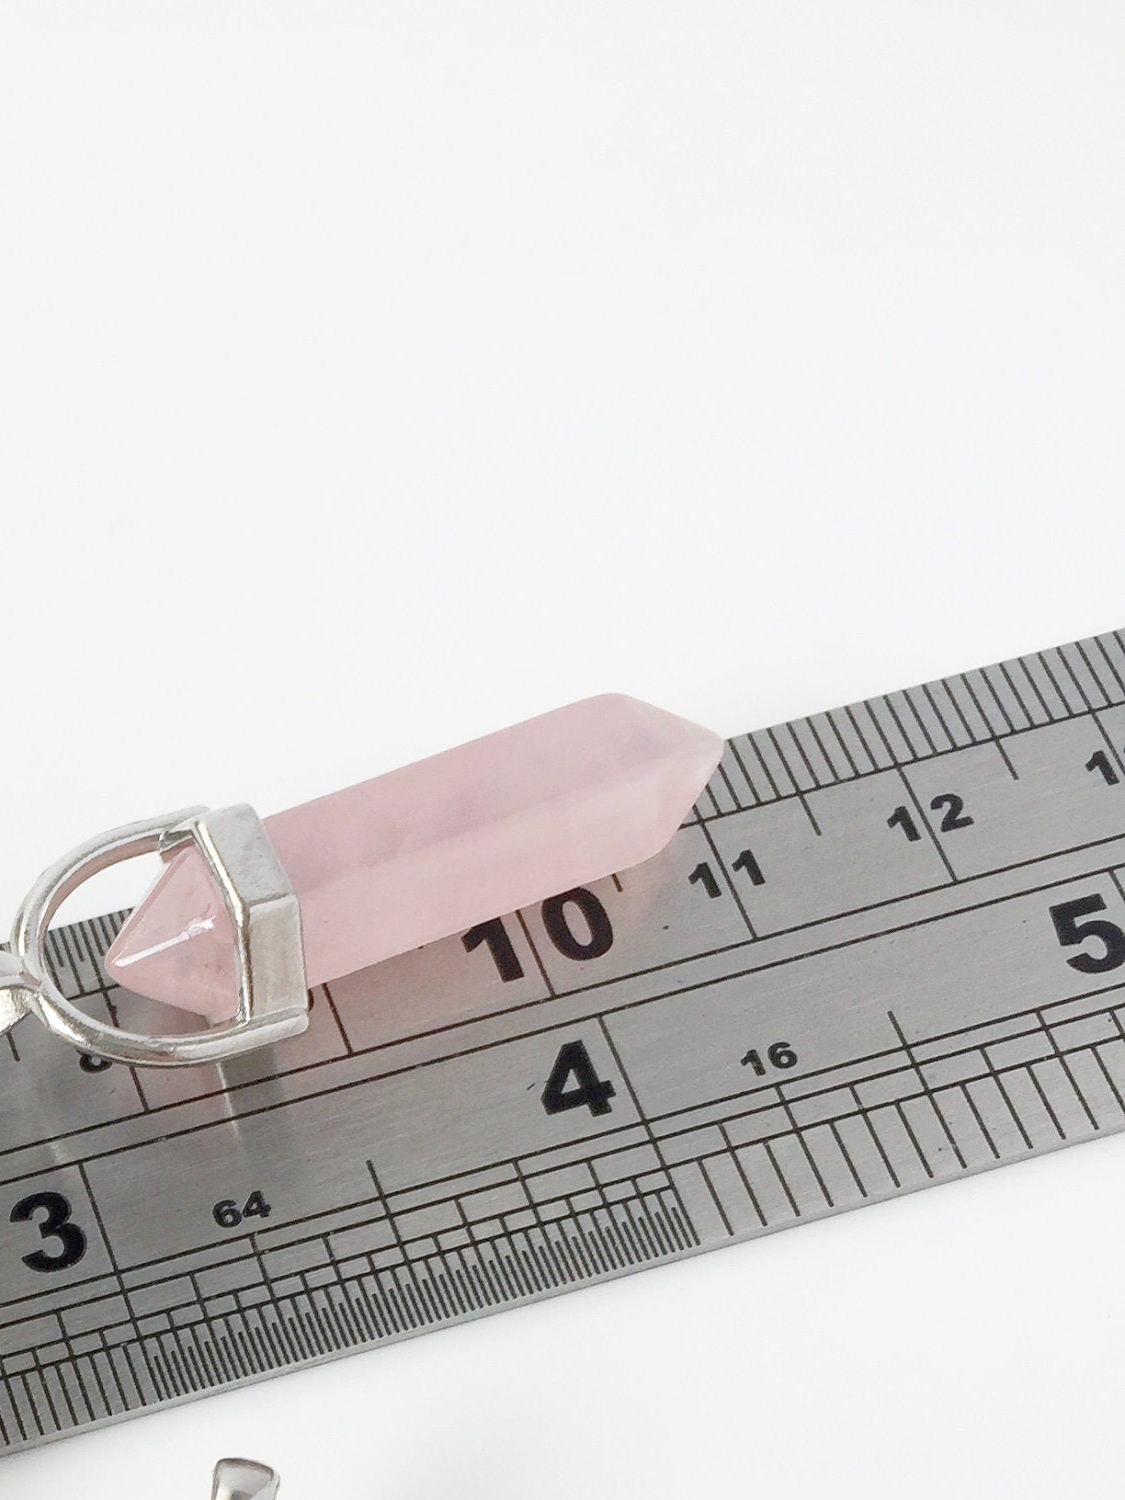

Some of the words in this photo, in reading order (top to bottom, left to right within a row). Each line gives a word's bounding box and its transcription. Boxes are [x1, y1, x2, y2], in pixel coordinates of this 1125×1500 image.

[460, 886, 615, 983] 10
[688, 849, 766, 899] 11
[886, 793, 974, 842] 12
[1084, 748, 1125, 786] 1
[9, 1191, 88, 1273] 3
[540, 1040, 617, 1118] 4
[1048, 893, 1125, 974] 5
[740, 1041, 799, 1076] 16
[212, 1190, 272, 1227] 64
